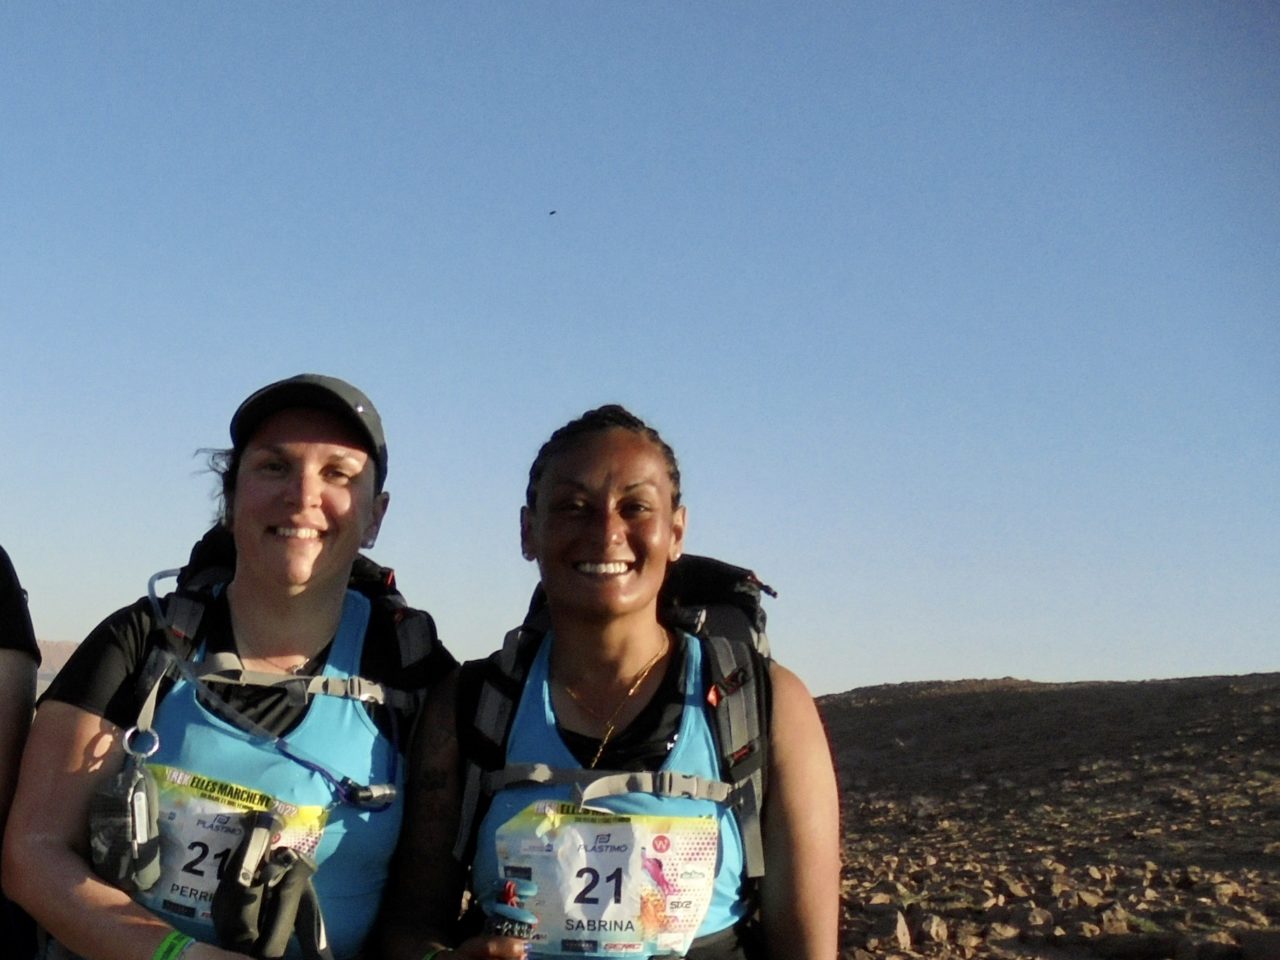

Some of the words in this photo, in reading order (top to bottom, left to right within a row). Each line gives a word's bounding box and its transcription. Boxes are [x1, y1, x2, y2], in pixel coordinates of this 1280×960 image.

[190, 776, 218, 793] ELLES
[217, 783, 272, 808] MARCHENT
[196, 819, 242, 836] PLASTIMO
[577, 844, 627, 853] PLASTIMO
[182, 841, 232, 880] 21
[170, 883, 214, 903] PERRI
[573, 867, 622, 904] 21
[564, 919, 635, 932] SABRINA
